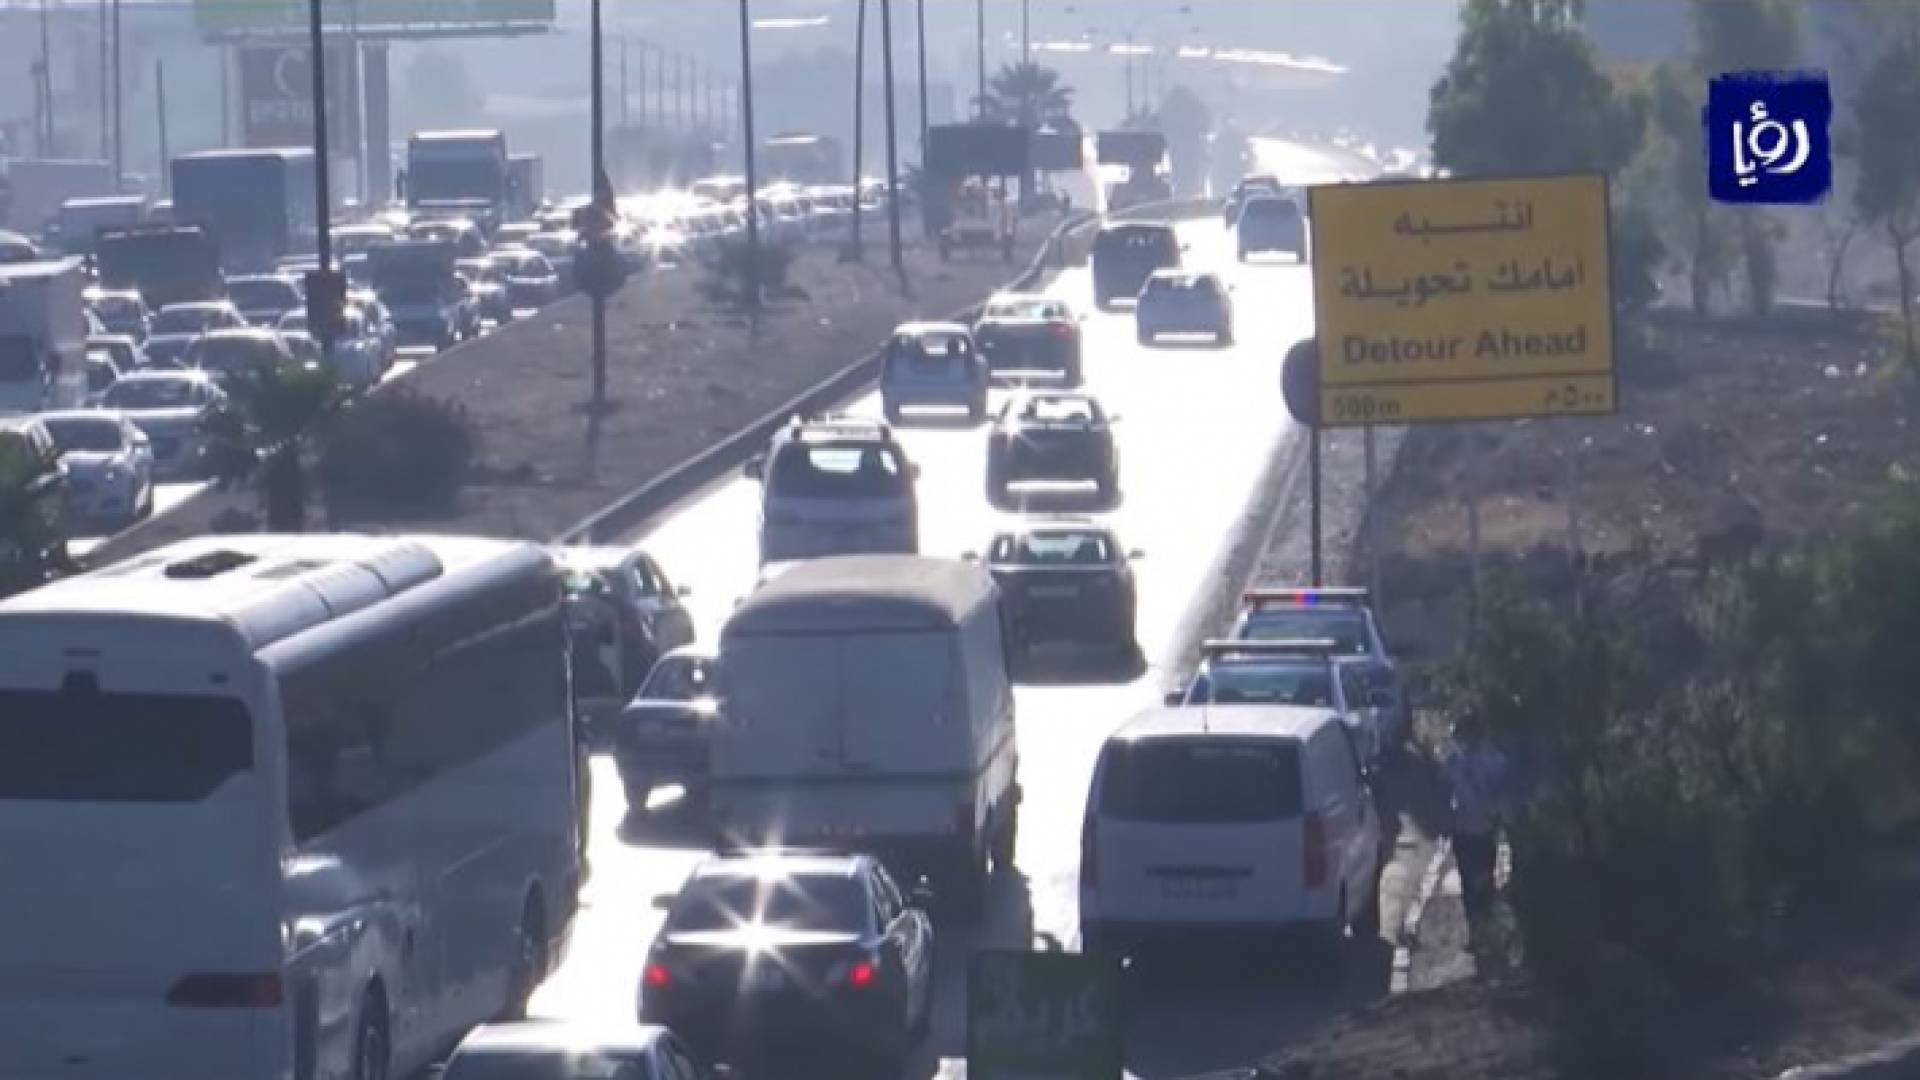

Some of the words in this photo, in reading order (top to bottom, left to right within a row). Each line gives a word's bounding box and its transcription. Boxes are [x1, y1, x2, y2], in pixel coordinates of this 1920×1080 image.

[1341, 260, 1472, 308] تحويلة
[1343, 333, 1464, 365] Detour
[1475, 324, 1586, 359] Ahead
